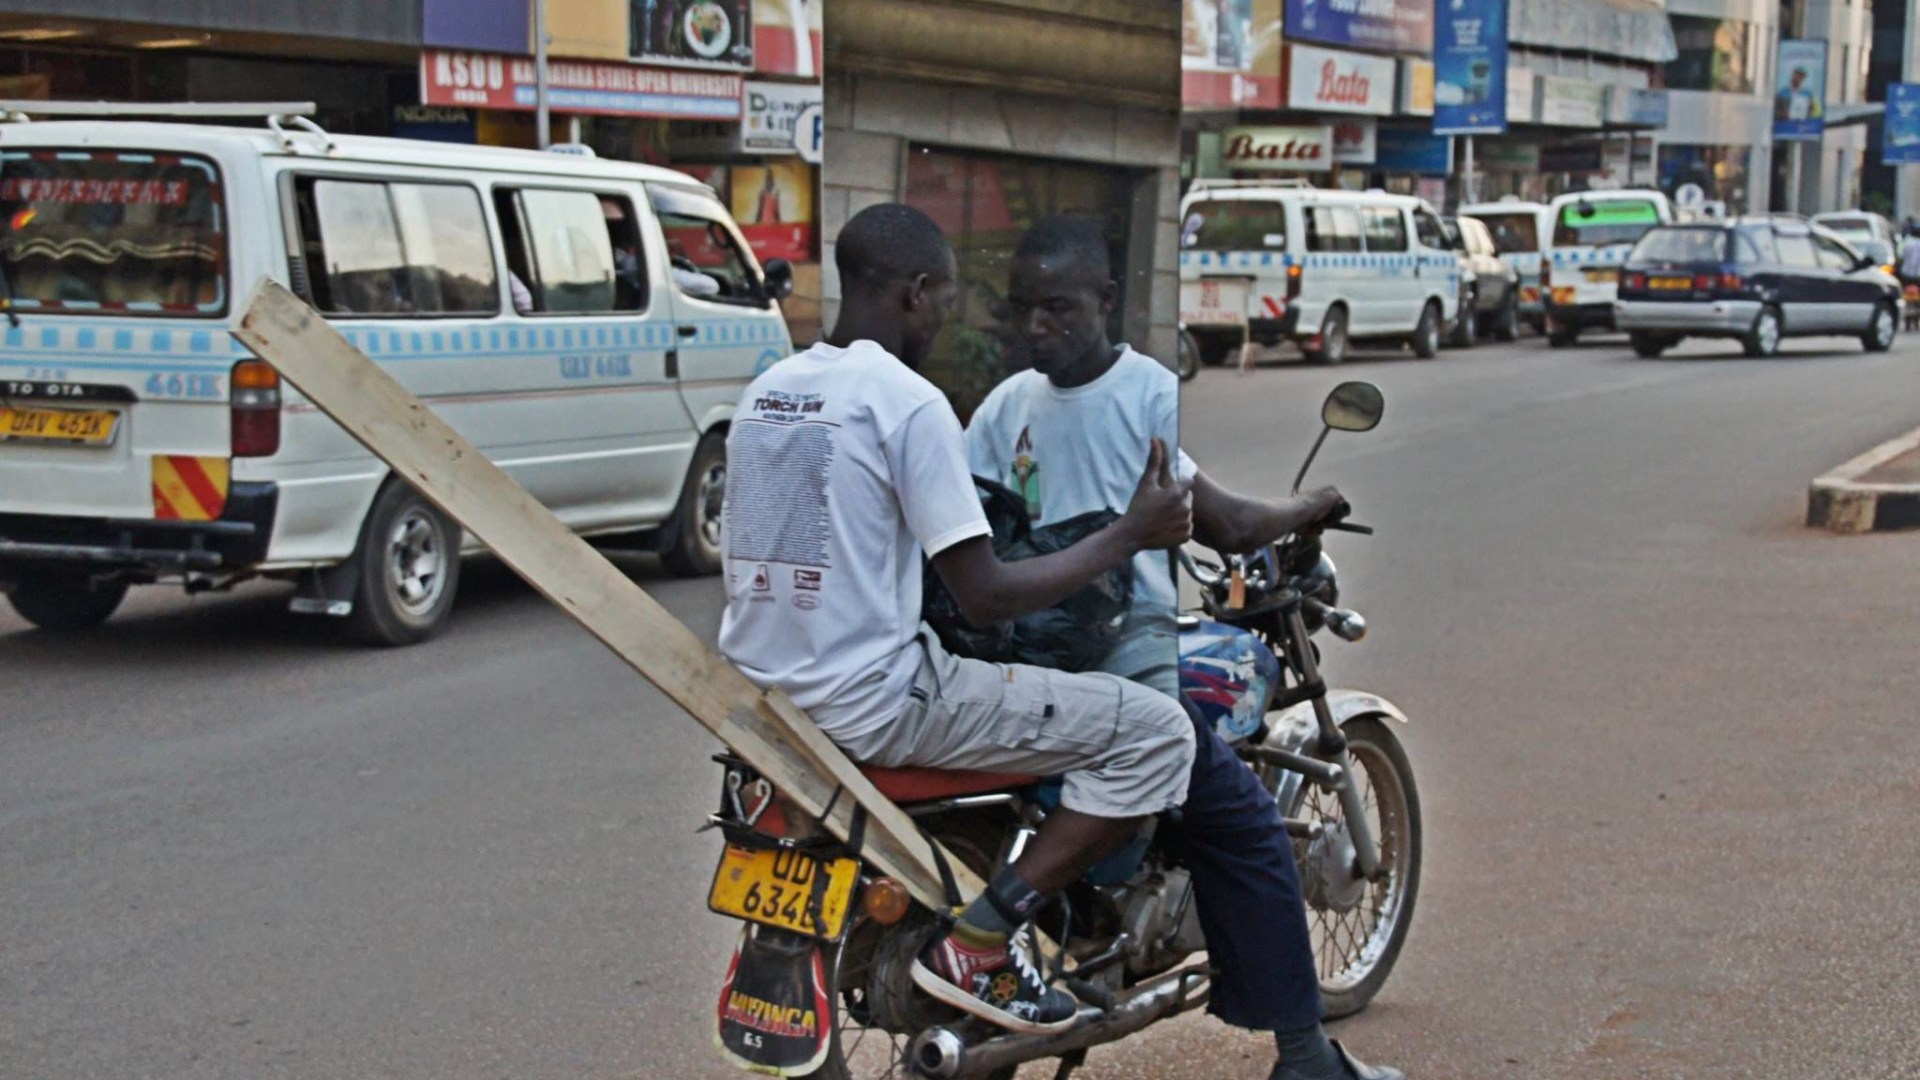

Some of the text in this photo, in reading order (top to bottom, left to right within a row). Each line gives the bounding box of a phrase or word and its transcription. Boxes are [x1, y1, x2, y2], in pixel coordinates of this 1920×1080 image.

[435, 53, 503, 90] KSOU
[597, 65, 635, 90] STATE
[671, 71, 742, 98] UNIVERSITY
[1316, 58, 1369, 106] Bata
[1225, 135, 1322, 161] Bata
[753, 398, 800, 413] TORCH
